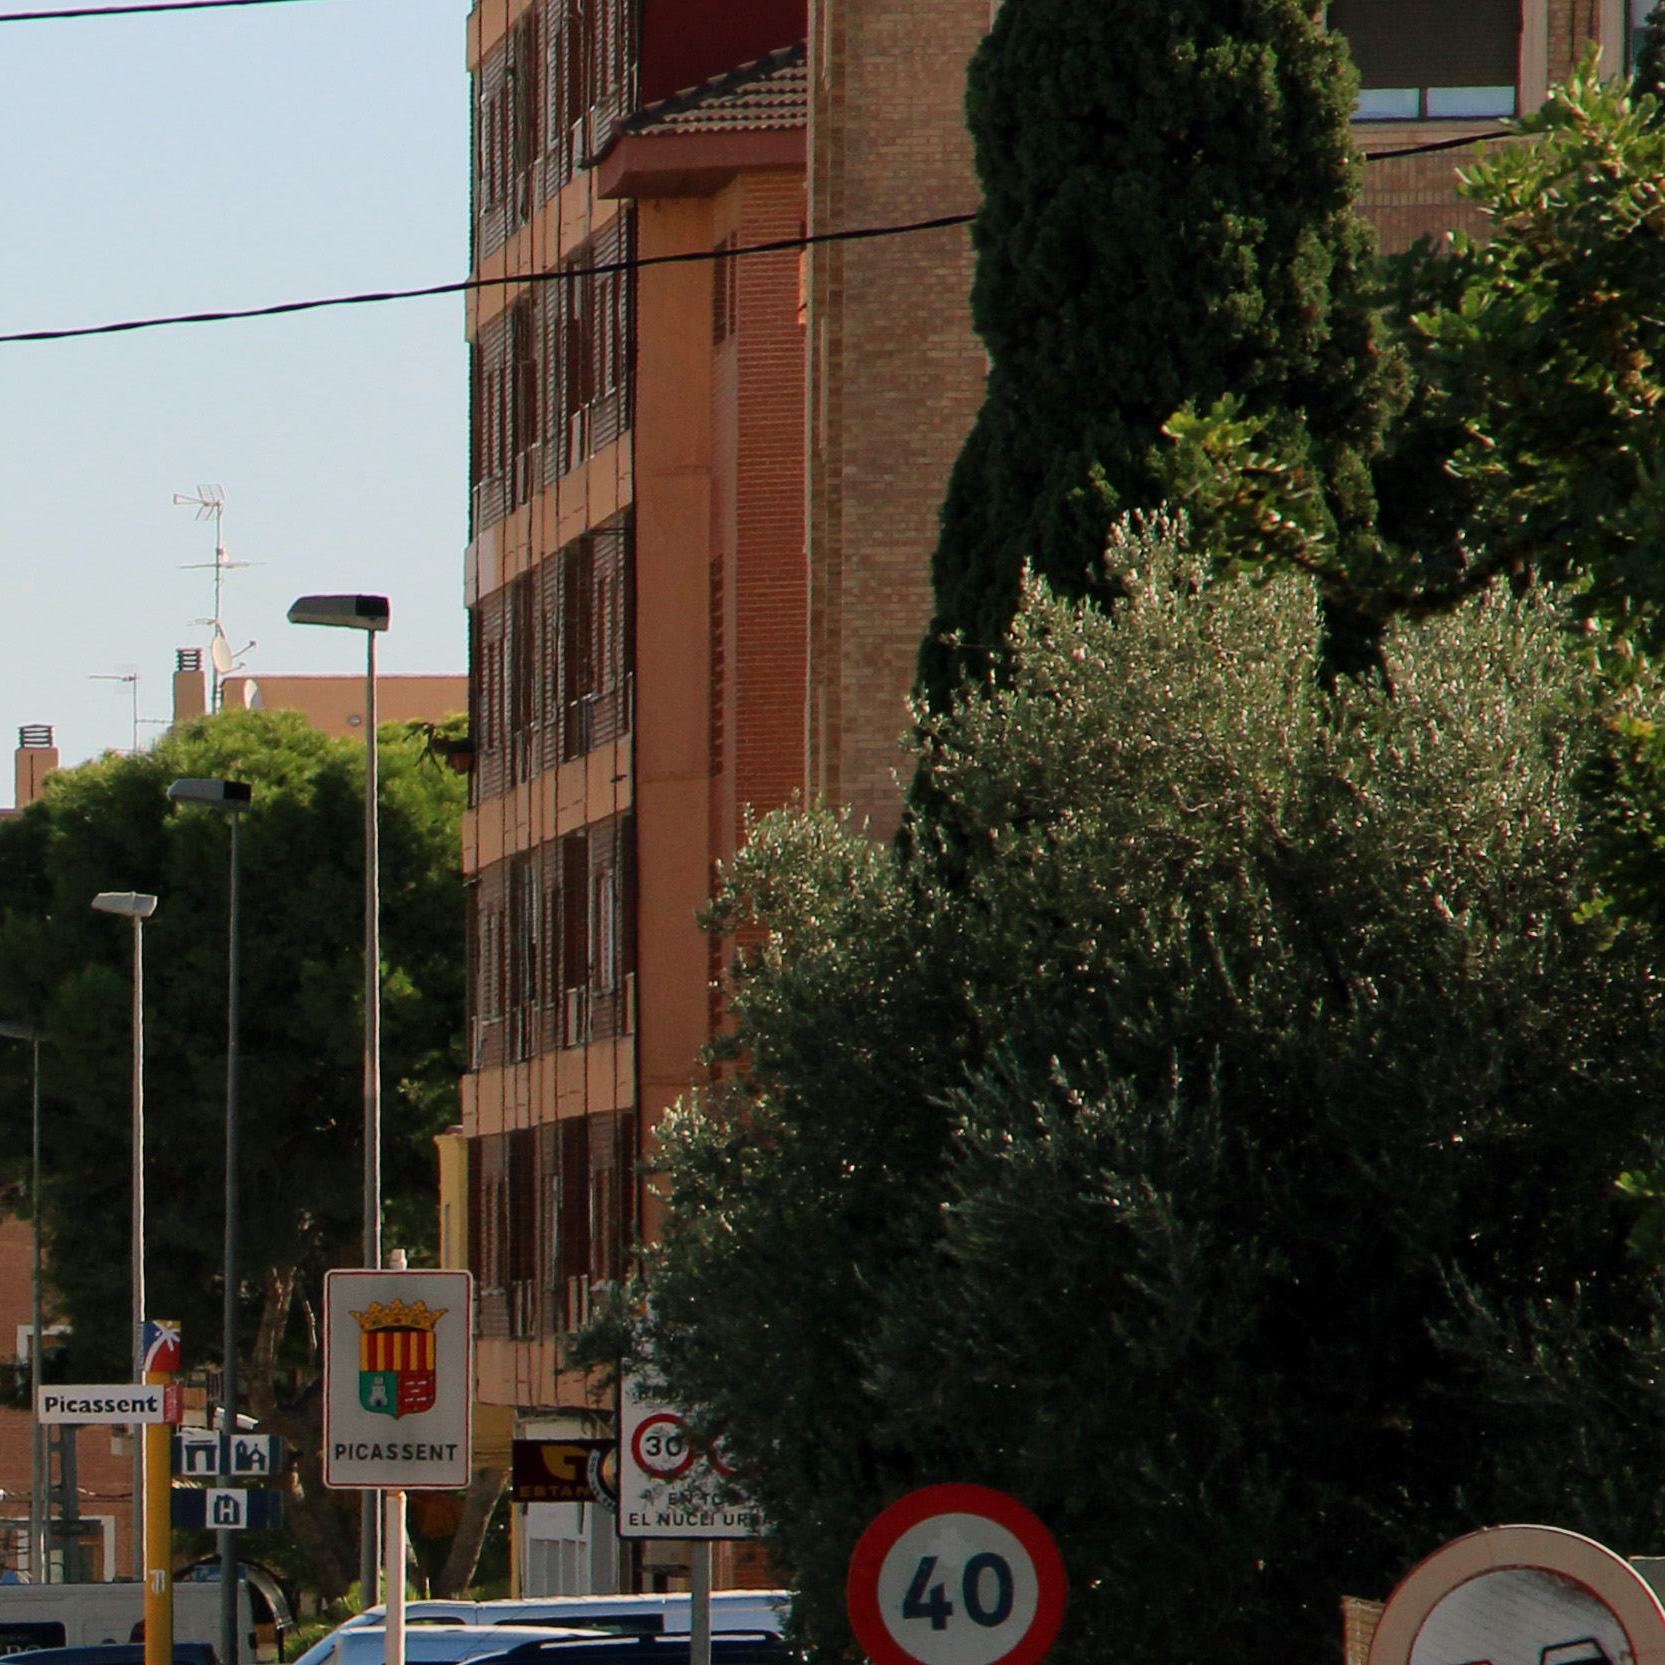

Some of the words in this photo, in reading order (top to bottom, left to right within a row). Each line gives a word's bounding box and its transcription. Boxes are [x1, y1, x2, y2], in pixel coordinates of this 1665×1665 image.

[44, 1394, 158, 1413] Picassent
[334, 1442, 459, 1462] PICASSENT
[645, 1435, 685, 1457] 30
[629, 1511, 651, 1527] EL
[657, 1511, 715, 1527] NUCLI
[902, 1551, 1015, 1631] 40
